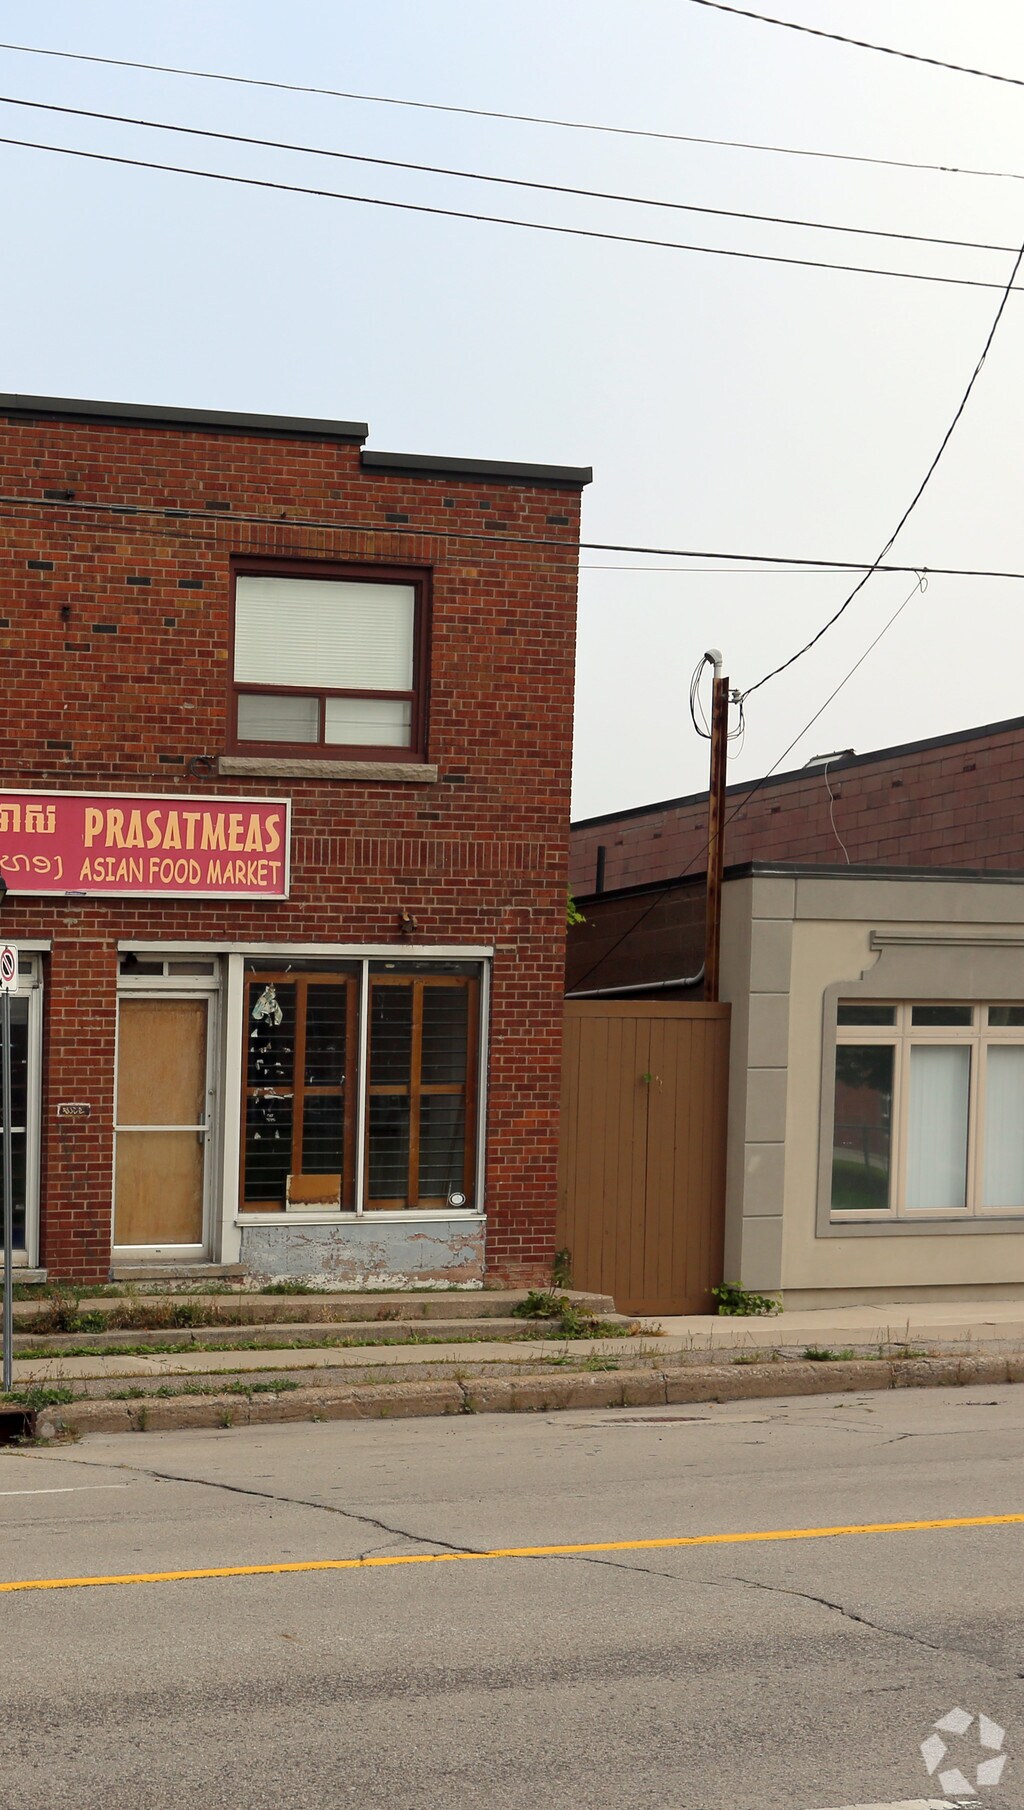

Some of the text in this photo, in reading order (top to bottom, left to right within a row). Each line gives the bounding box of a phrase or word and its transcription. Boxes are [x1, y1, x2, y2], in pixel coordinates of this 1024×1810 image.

[83, 807, 281, 853] PRASATMEAS
[79, 857, 281, 886] ASIAN FOOD MARKET
